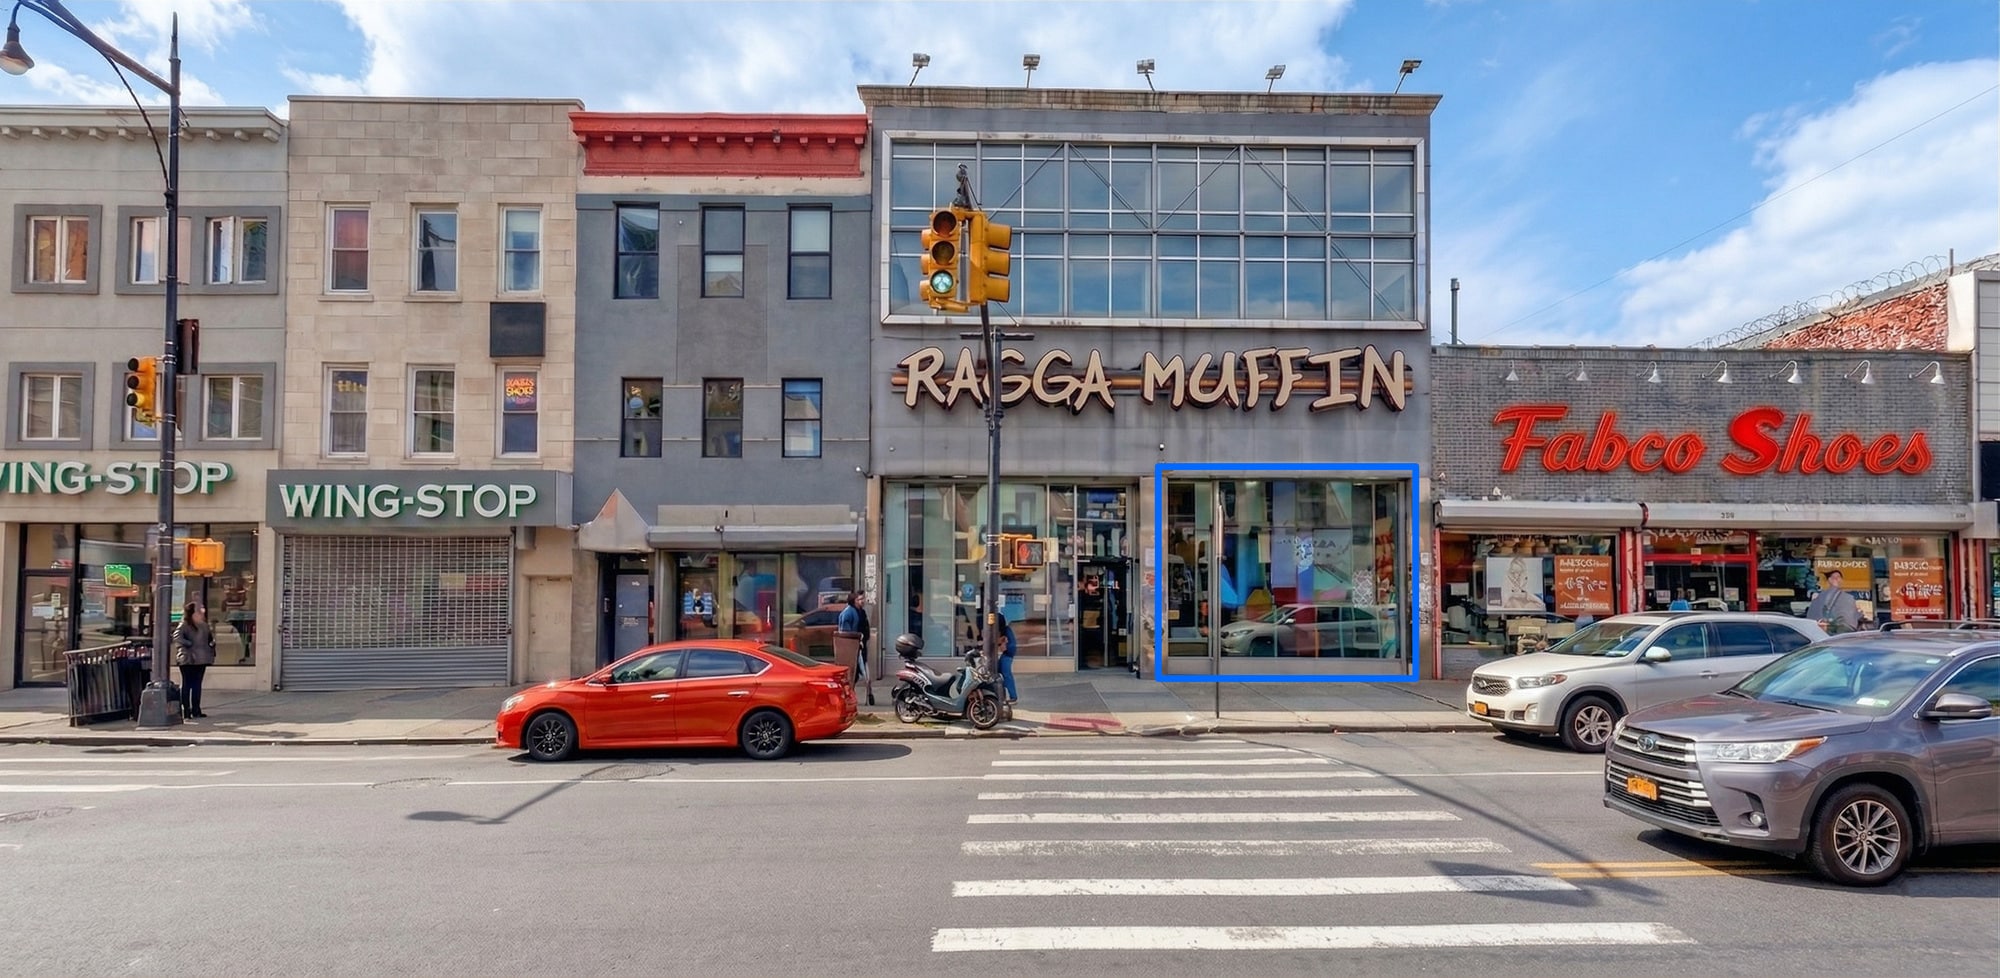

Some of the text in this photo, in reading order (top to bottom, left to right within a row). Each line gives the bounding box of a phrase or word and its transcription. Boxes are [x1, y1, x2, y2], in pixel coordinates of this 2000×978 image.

[901, 343, 1406, 414] RAGGA MUFFIN
[1493, 404, 1934, 475] Fabco Shoes
[0, 460, 233, 495] ING-STOP
[279, 483, 537, 519] WING-STOP
